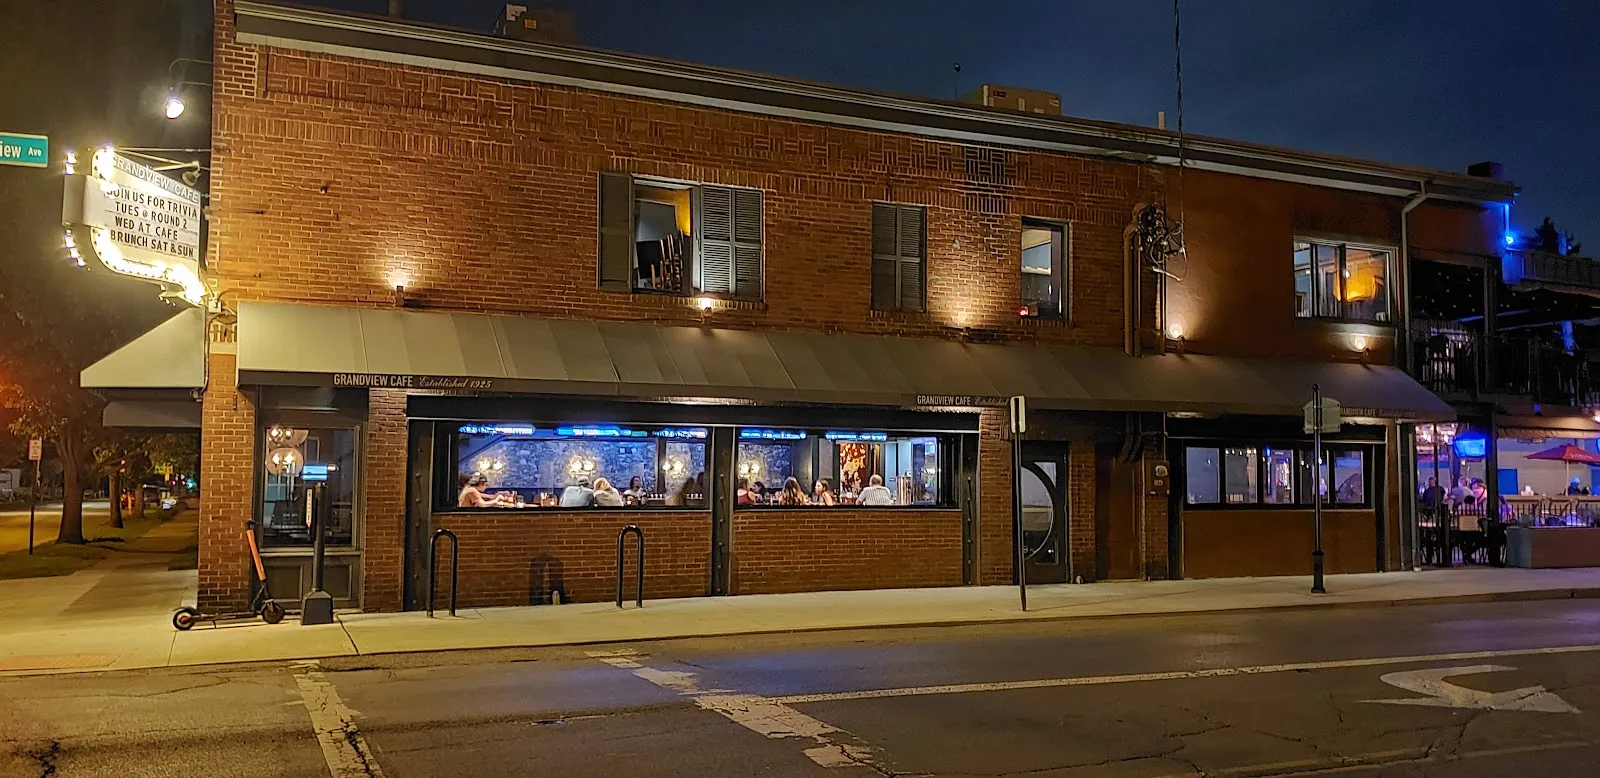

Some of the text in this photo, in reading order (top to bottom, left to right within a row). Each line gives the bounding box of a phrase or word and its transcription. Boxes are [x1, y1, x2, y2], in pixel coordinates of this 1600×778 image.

[28, 146, 42, 157] Ave
[174, 184, 199, 203] CAFE
[115, 201, 139, 217] TUES
[151, 211, 180, 227] ROUND
[183, 218, 188, 229] 2
[132, 191, 144, 204] US
[147, 195, 165, 210] FOR
[168, 201, 197, 219] TRIVIA
[115, 216, 178, 241] WED AT CAFE
[110, 229, 148, 248] BRUNCH
[151, 239, 168, 253] SAT
[333, 373, 492, 389] GRANDVIEW CAFE Established 1925
[916, 395, 954, 406] GRANDVIEW
[955, 396, 971, 406] CAFE
